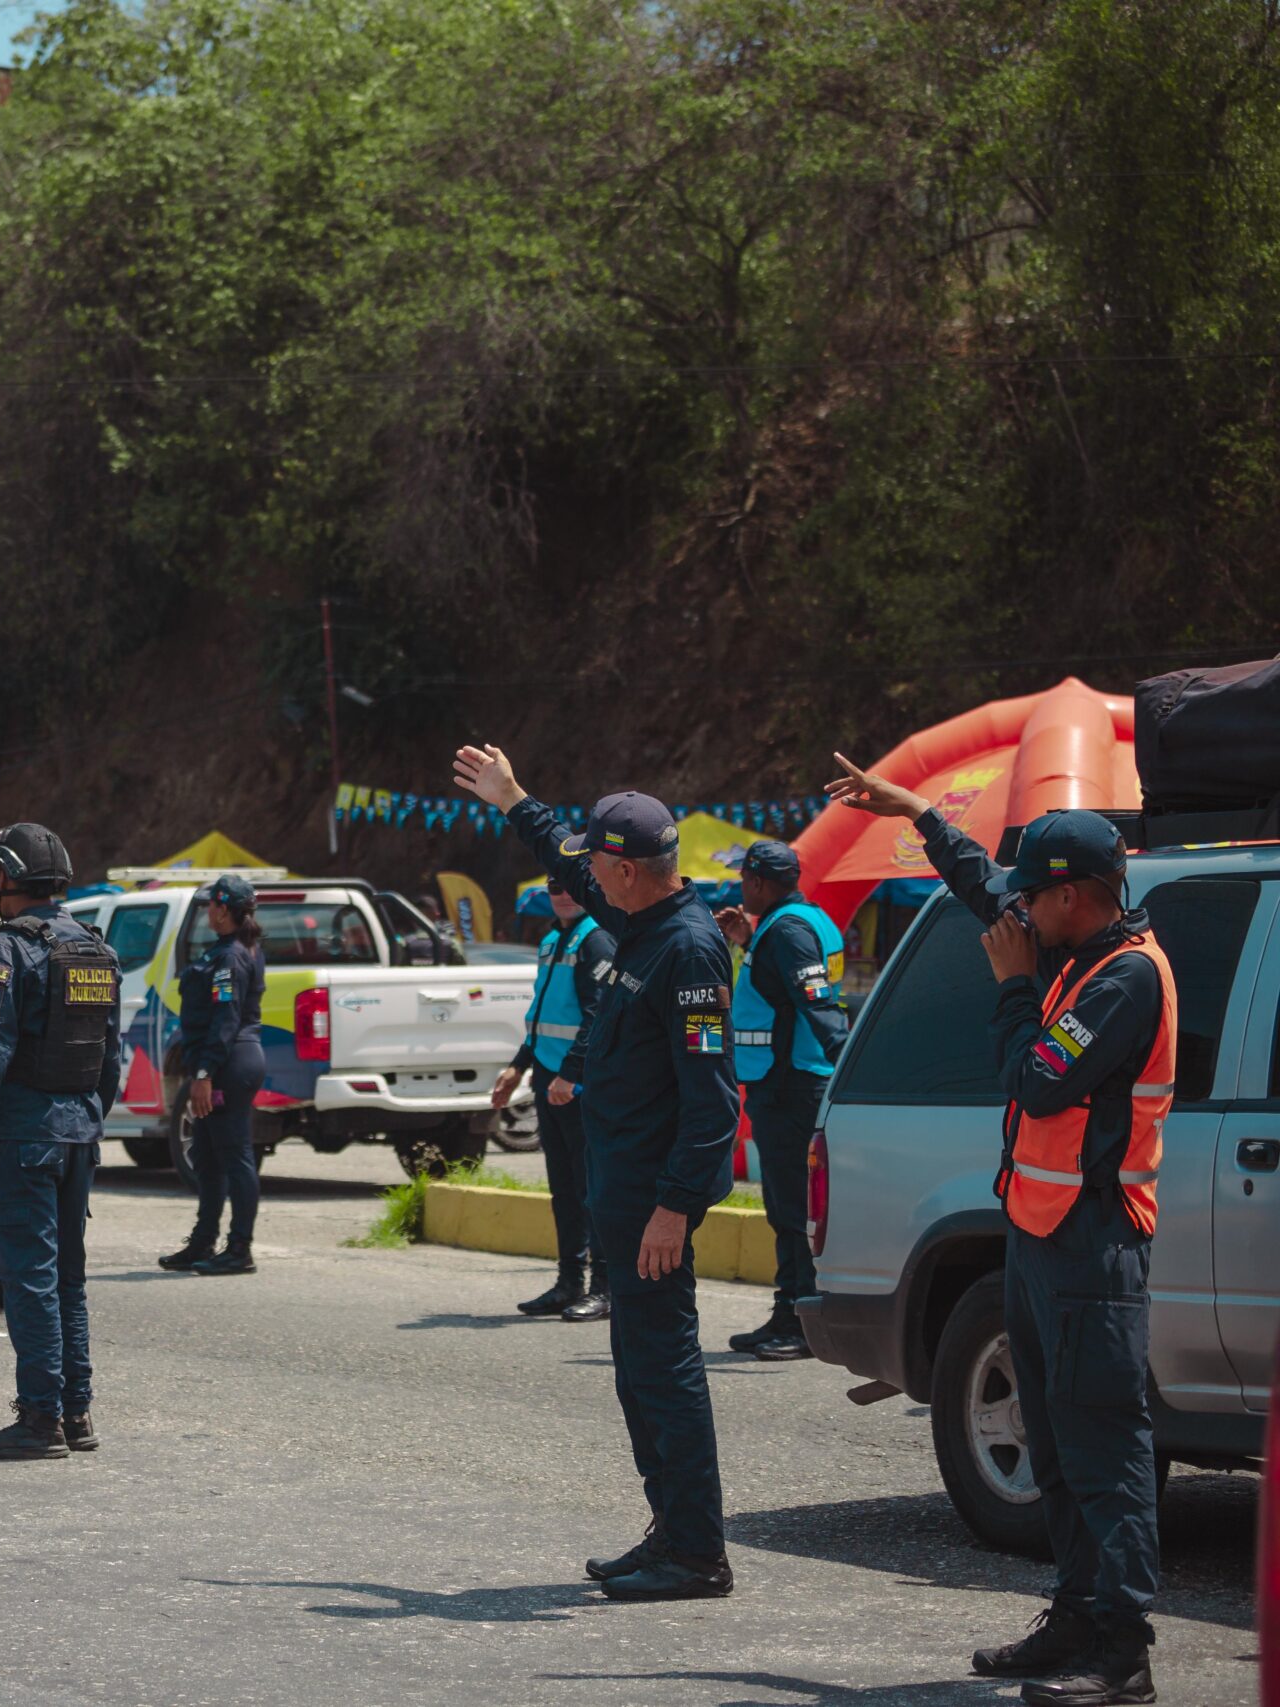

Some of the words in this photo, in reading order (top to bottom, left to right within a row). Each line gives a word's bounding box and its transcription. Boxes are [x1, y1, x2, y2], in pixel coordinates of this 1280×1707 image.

[68, 968, 113, 984] POLICIA
[70, 986, 113, 1003] MUNICIPAL
[687, 1015, 702, 1023] PUERTO
[1058, 1012, 1094, 1048] CPNB
